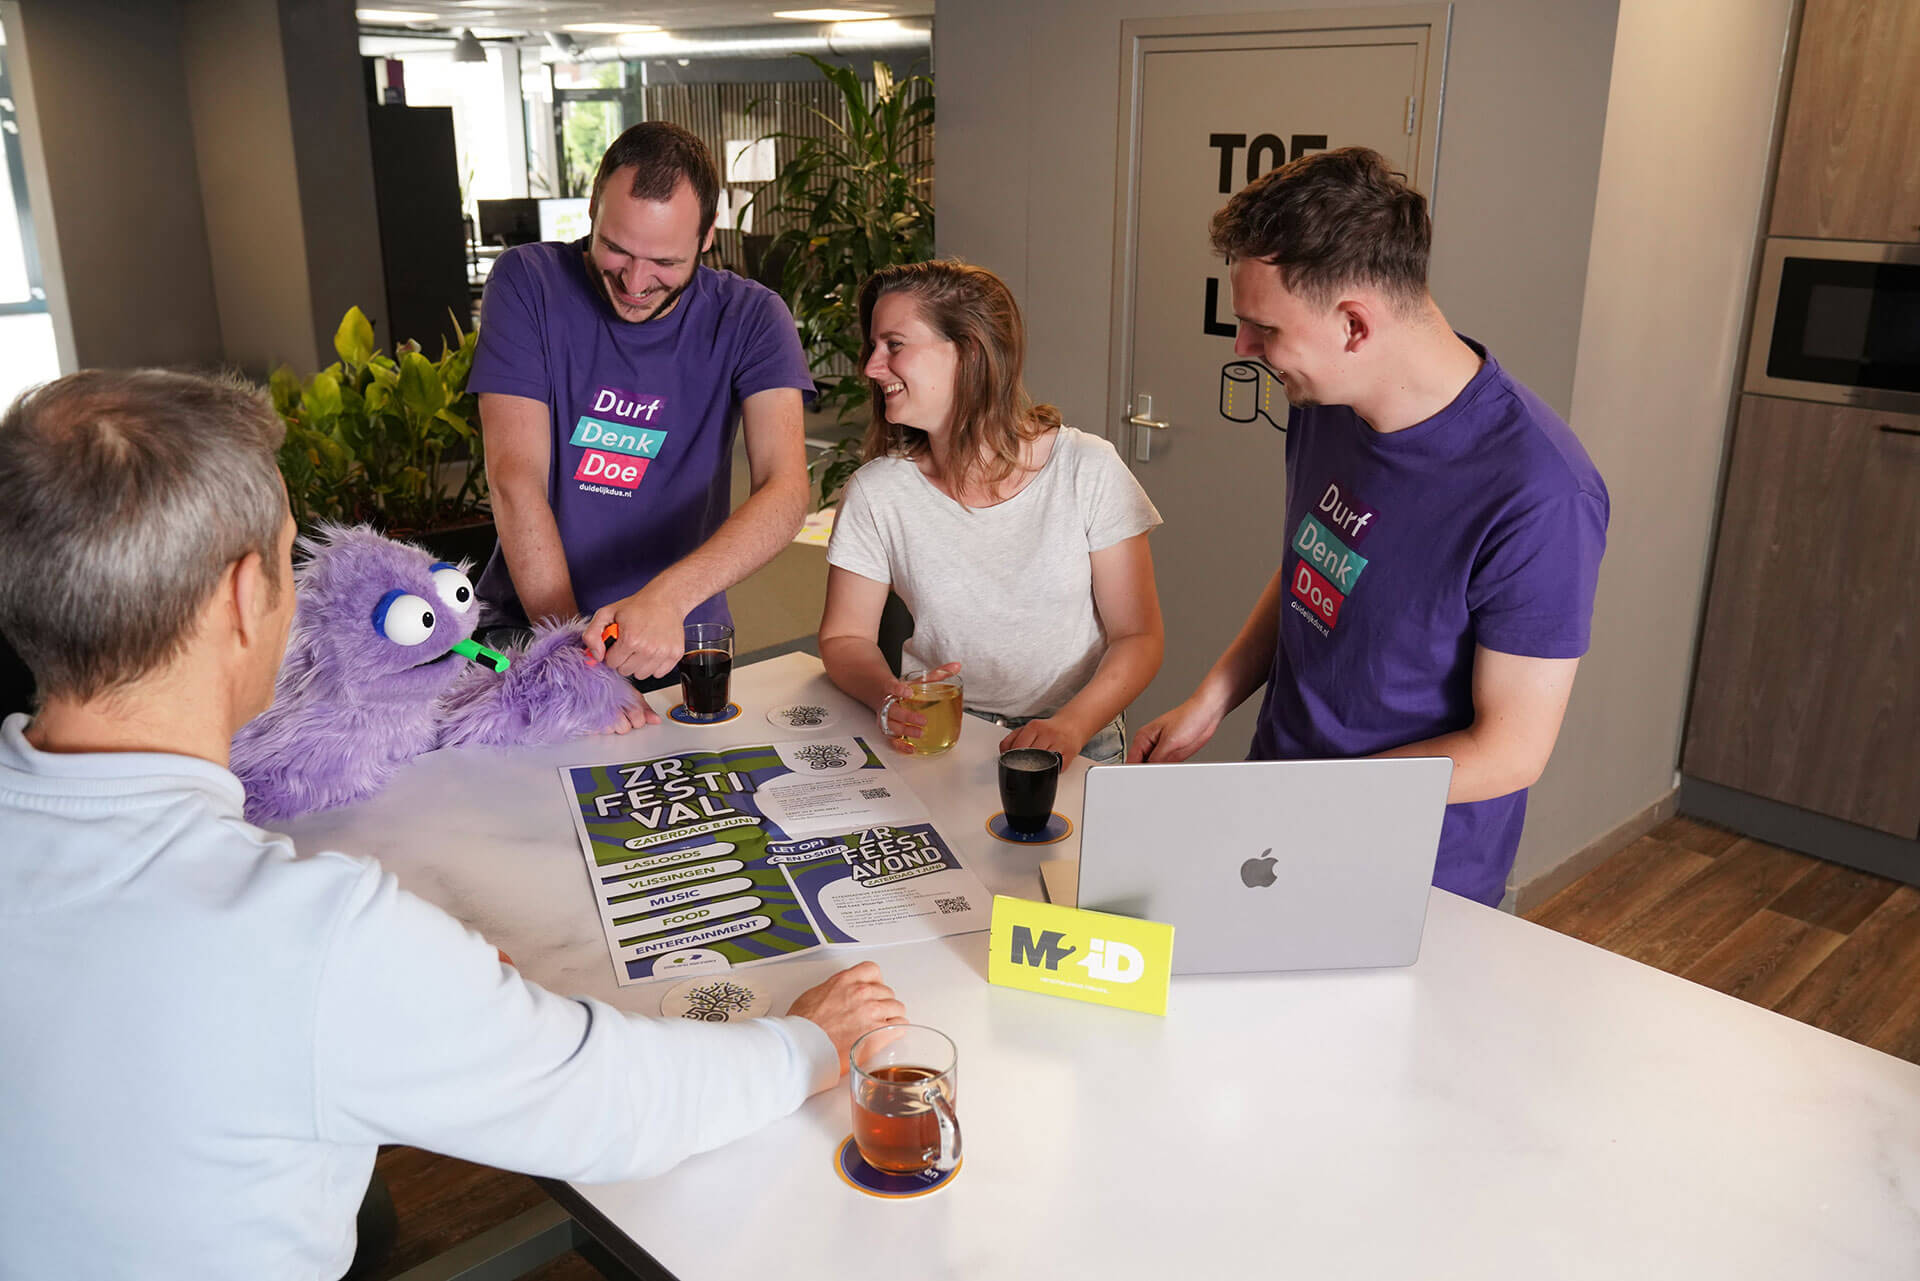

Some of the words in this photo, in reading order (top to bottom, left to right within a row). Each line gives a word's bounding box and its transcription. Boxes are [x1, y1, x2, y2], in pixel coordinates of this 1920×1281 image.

[1209, 133, 1328, 194] TO
[593, 389, 660, 421] Durf
[581, 421, 654, 453] Denk
[583, 453, 638, 482] Doe
[579, 483, 632, 498] duidelijkdus.nl
[1319, 483, 1373, 537] Durf
[1298, 522, 1352, 585] Denk
[1296, 567, 1334, 617] Doe
[619, 758, 684, 789] ZR
[594, 771, 744, 817] FESTI
[630, 795, 736, 829] VAL
[633, 824, 709, 847] ZATERDAG
[722, 817, 753, 827] JUNI
[799, 839, 825, 850] OP!
[853, 826, 892, 845] ZR
[624, 850, 702, 871] LASLOODS
[803, 846, 842, 860] D-SHIFT
[841, 831, 931, 865] FEEST
[628, 866, 716, 890] VLISSINGEN
[852, 847, 943, 881] AVOND
[868, 871, 914, 886] ZATERDAG
[921, 863, 942, 873] JUNI
[649, 889, 701, 907] MUSIC
[662, 909, 711, 926] FOOD
[635, 919, 759, 955] ENTERTAINMENT
